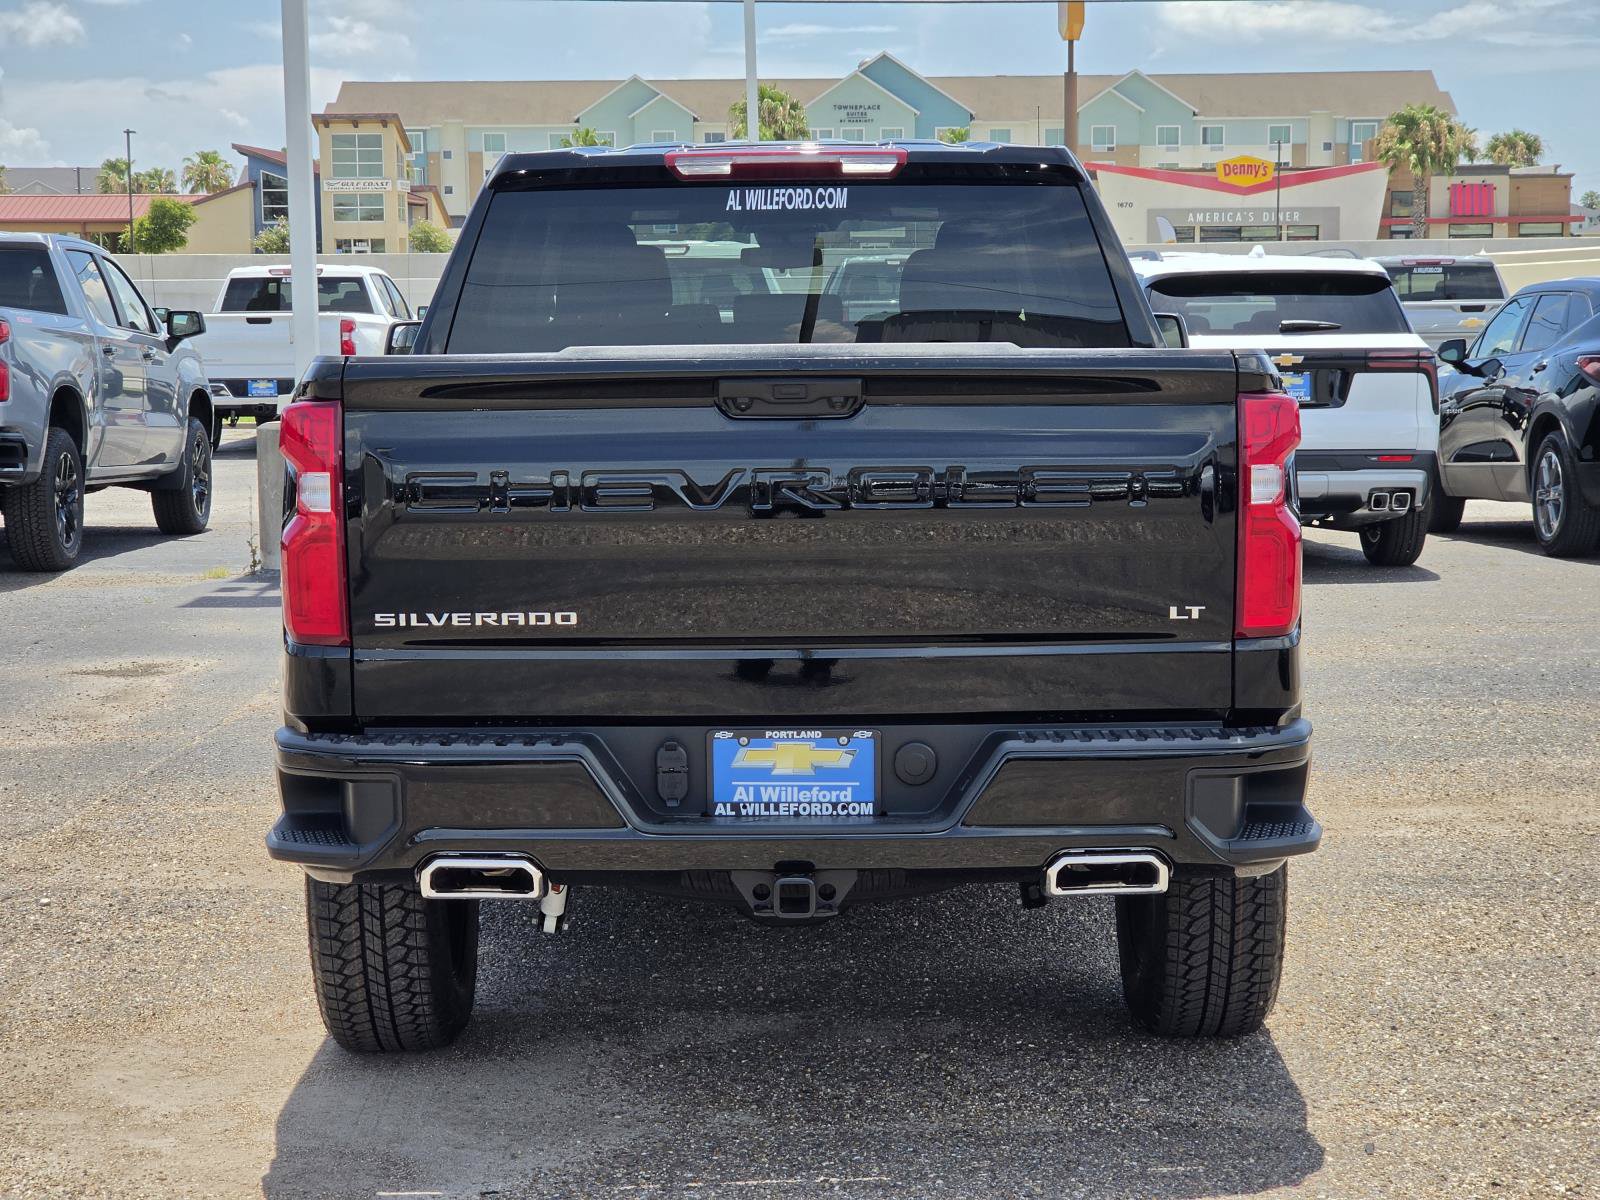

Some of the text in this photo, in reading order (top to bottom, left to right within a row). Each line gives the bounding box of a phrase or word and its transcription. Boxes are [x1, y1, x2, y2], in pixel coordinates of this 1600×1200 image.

[1222, 161, 1268, 178] Denny's
[726, 187, 848, 211] AL WILLEFORD.COM
[1187, 211, 1301, 223] AMERICA'S DINER
[405, 466, 1186, 513] CHEVROLET
[374, 611, 578, 627] SILVERADO
[1169, 605, 1206, 620] LT
[765, 730, 822, 739] PORTLAND
[733, 786, 852, 802] Al Willeford
[714, 802, 873, 816] AL WILLEFORD.COM
